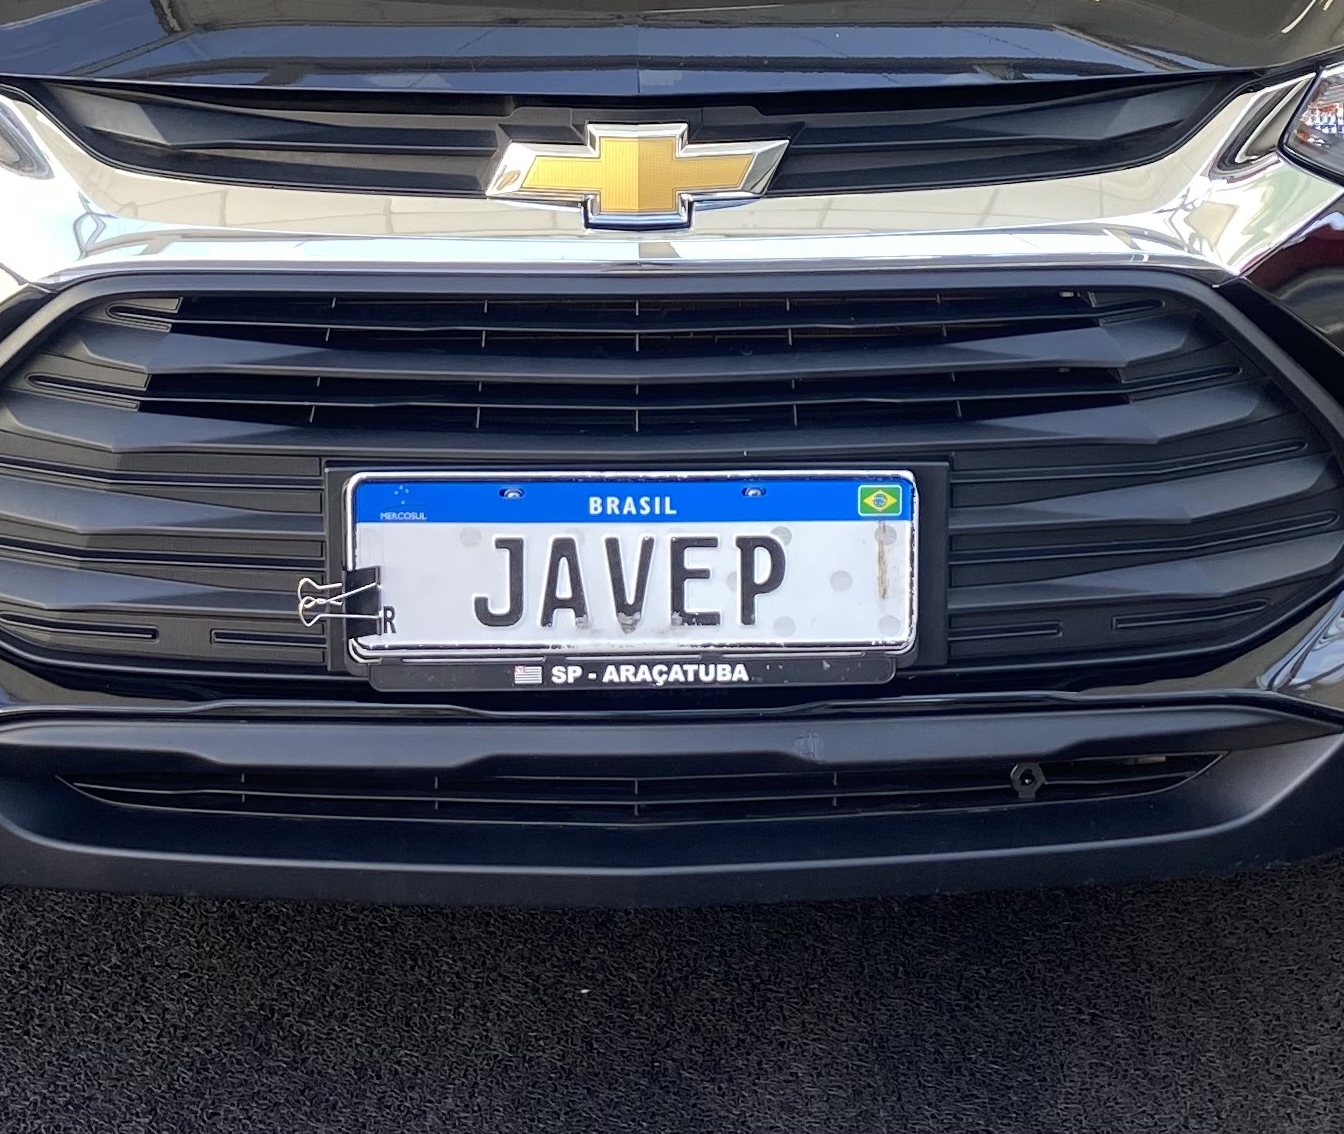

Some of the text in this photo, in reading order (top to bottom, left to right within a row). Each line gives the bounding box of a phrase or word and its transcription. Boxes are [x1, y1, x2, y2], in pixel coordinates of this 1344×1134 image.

[588, 496, 677, 515] BRASIL
[380, 512, 427, 521] MERCOSUL
[473, 535, 787, 635] JAVEP
[602, 663, 749, 686] ARAÇATUBA
